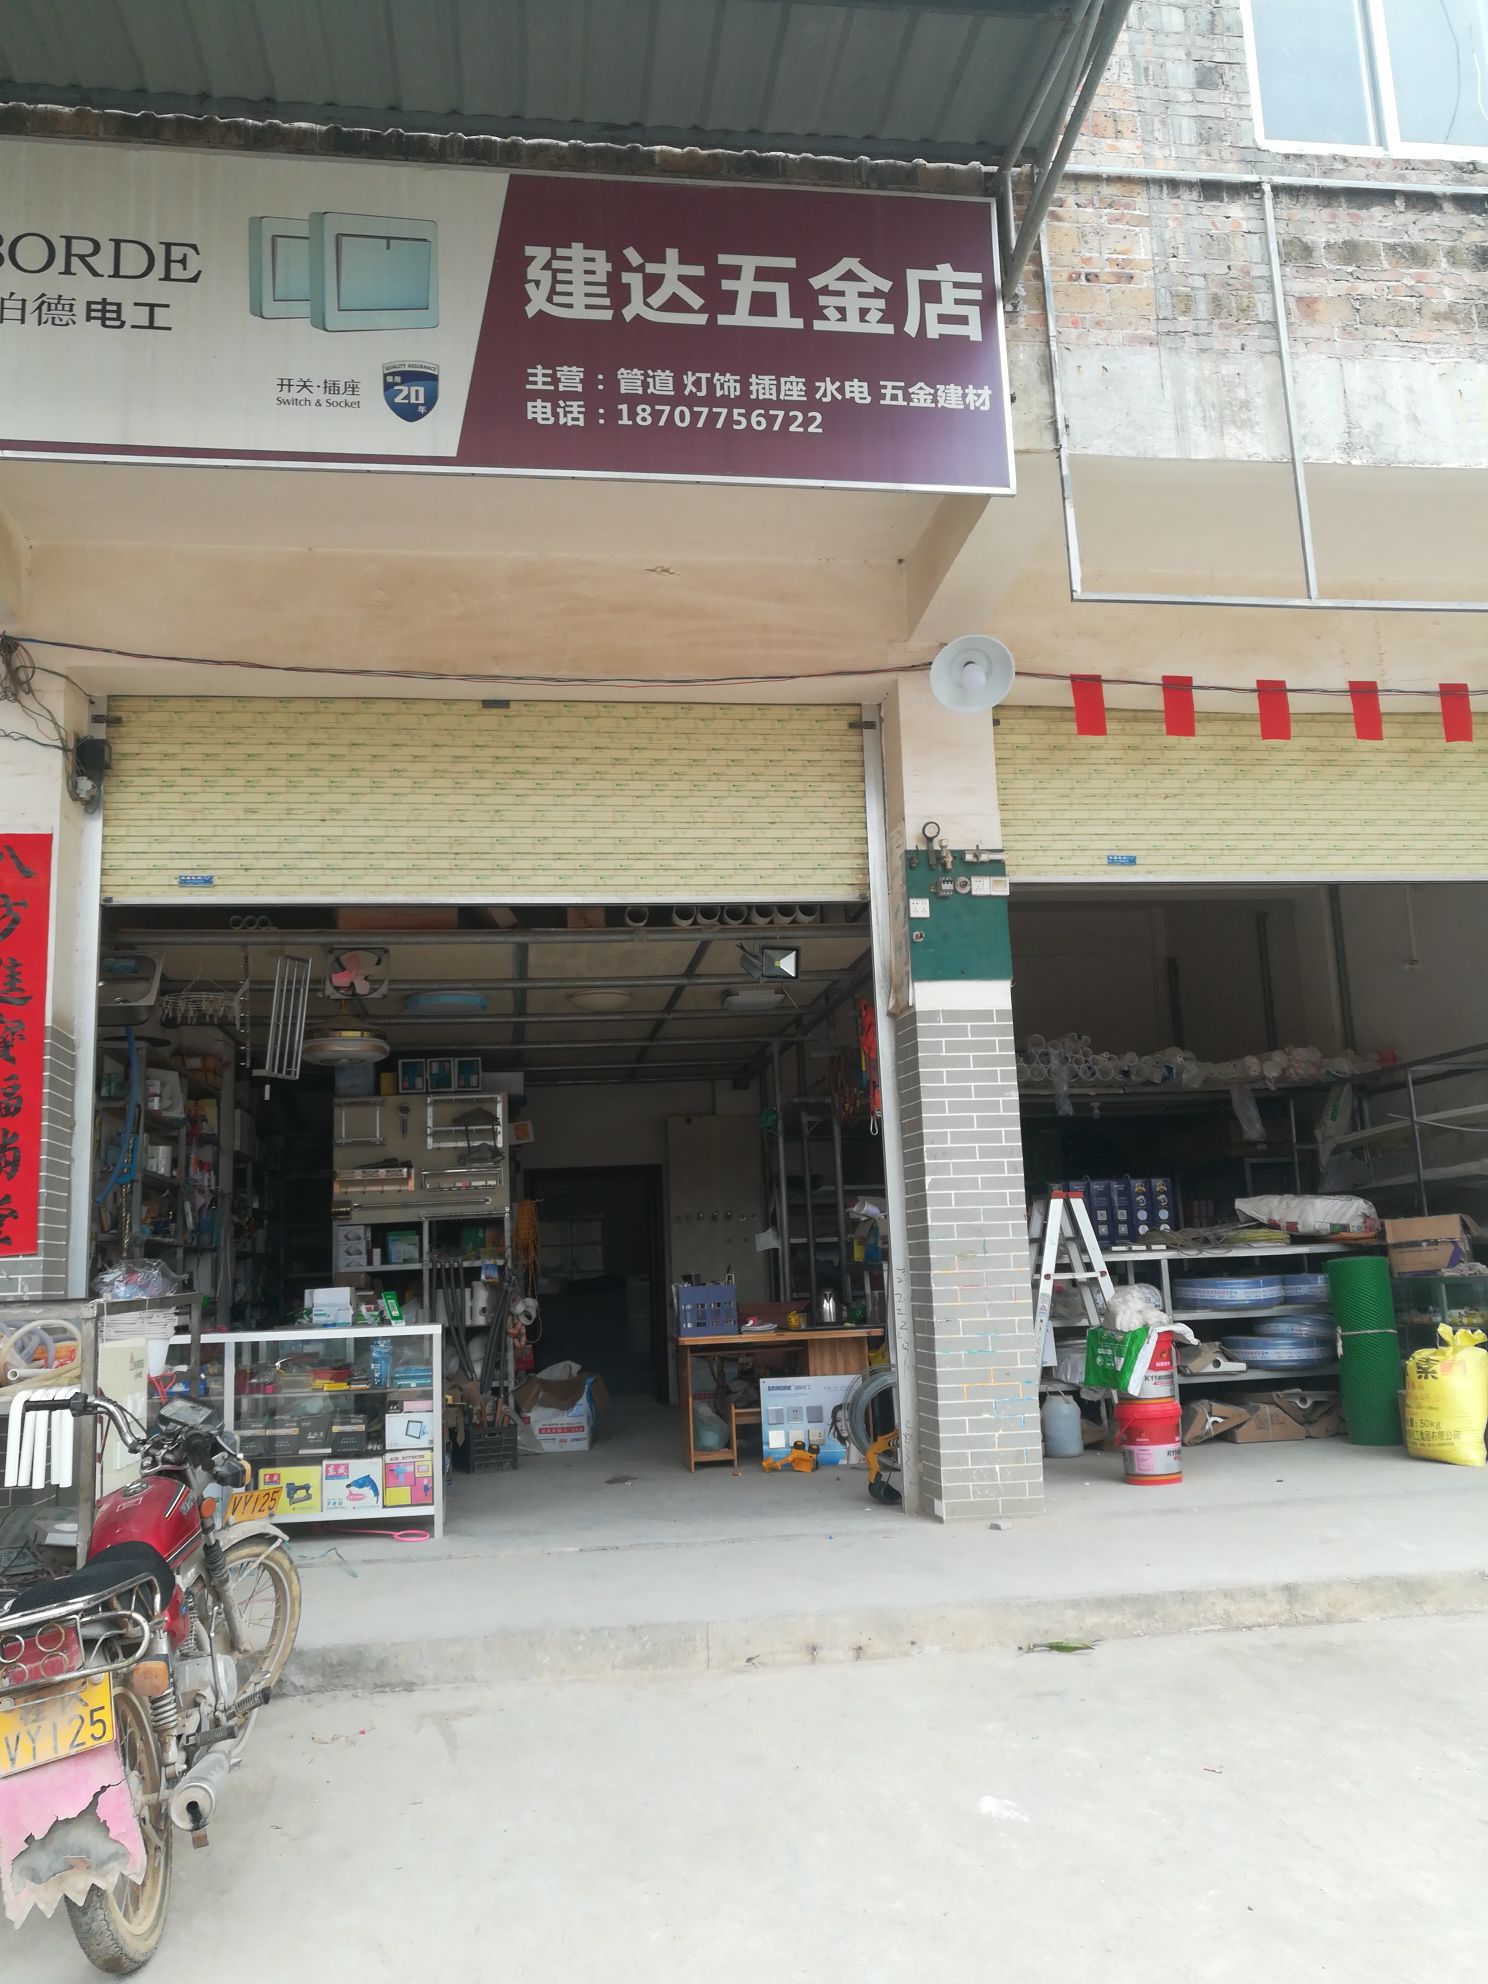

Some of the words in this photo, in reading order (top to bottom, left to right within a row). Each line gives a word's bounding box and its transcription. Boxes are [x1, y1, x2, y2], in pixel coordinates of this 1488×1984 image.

[0, 232, 202, 283] ORDE
[524, 242, 983, 341] 建达五金店
[276, 396, 311, 407] Switch
[315, 398, 322, 407] &
[326, 398, 361, 409] Socket
[394, 385, 425, 404] 20
[683, 372, 741, 399] 灯饰
[749, 375, 807, 401] 插座
[815, 378, 871, 405] 水电
[879, 381, 992, 412] 五金建材
[231, 1490, 280, 1516] VY125
[4, 1706, 107, 1769] VY125
